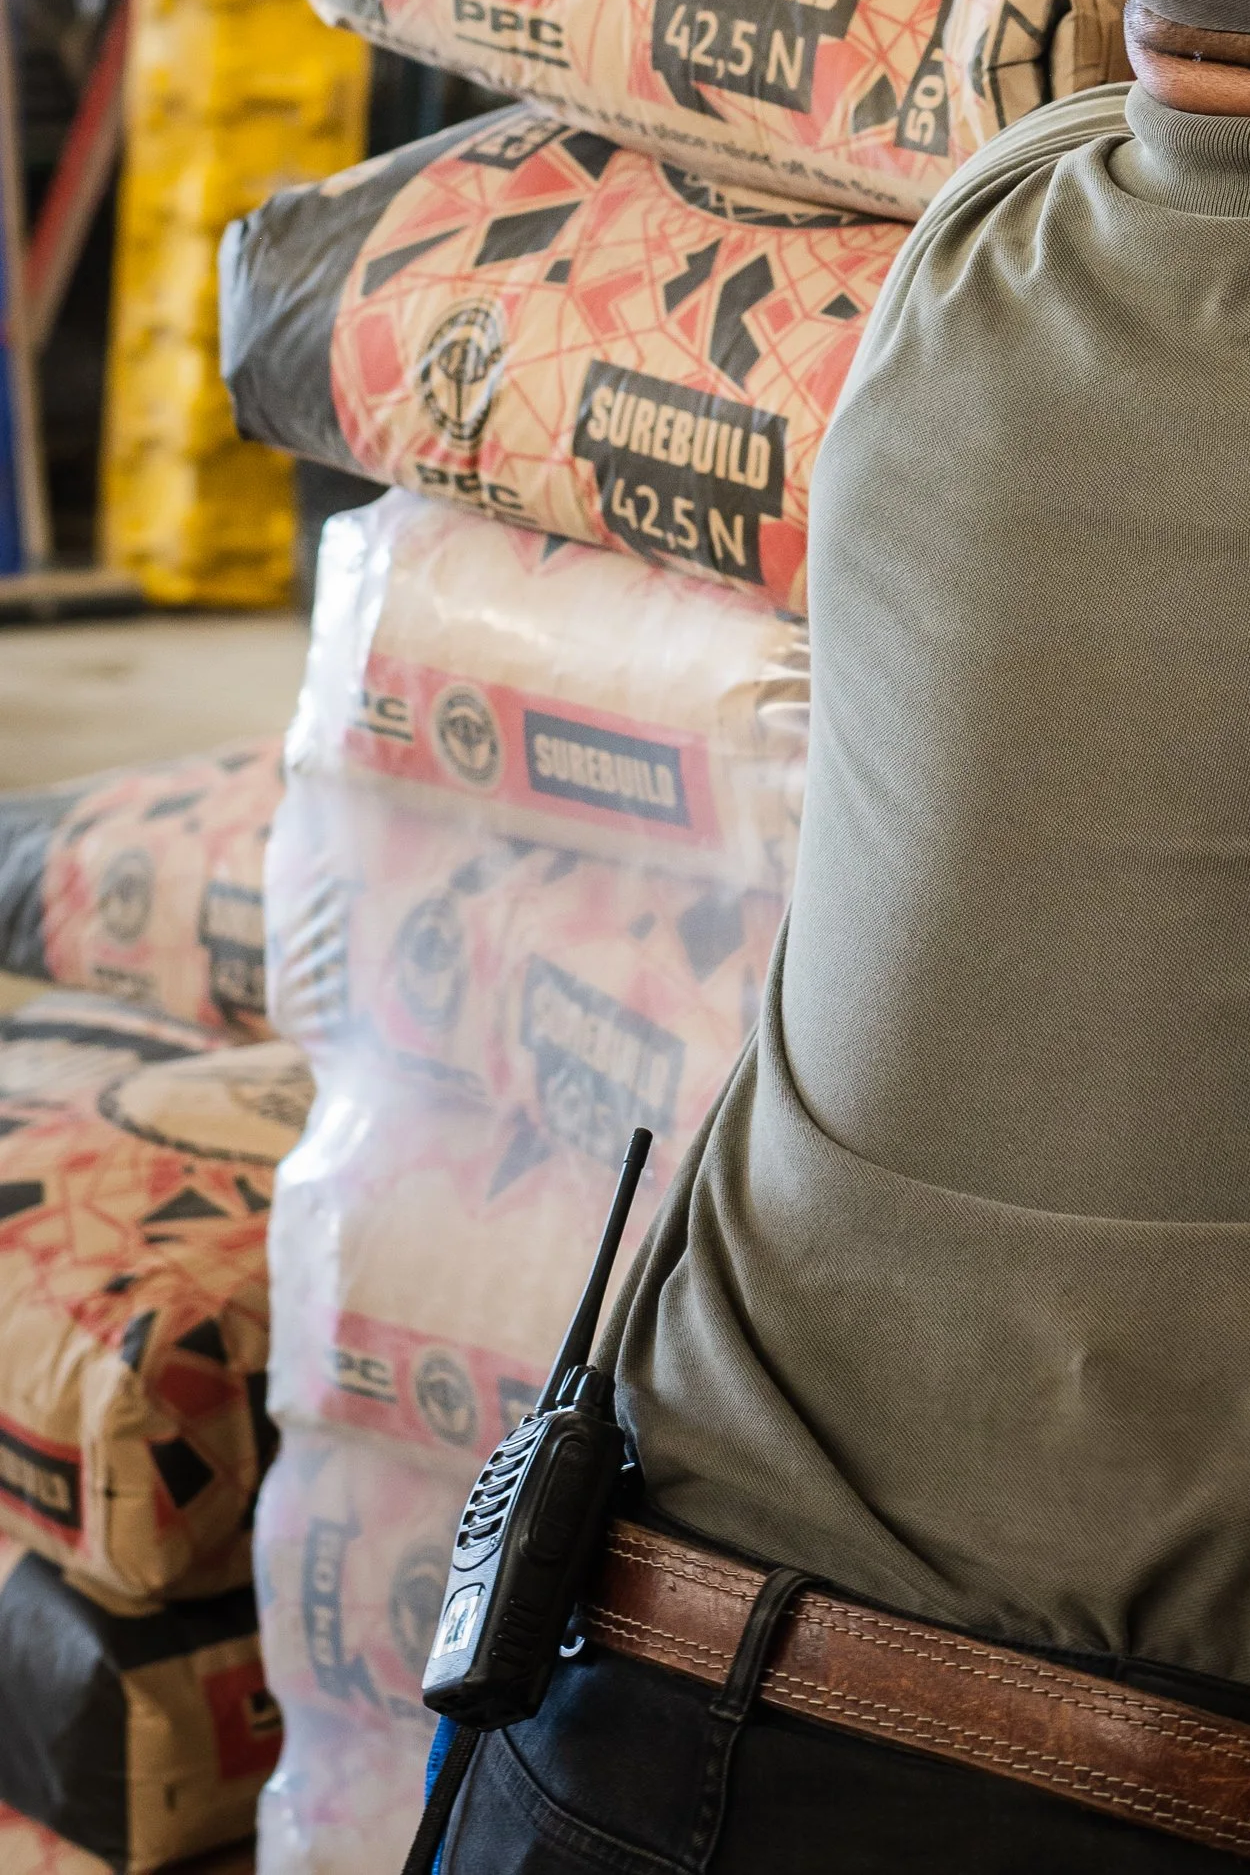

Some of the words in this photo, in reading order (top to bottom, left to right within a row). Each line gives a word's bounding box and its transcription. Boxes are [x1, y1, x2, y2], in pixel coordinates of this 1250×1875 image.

[665, 4, 757, 80] 42,5
[766, 29, 806, 91] N
[904, 74, 945, 147] 50
[587, 384, 770, 490] SUREBUILD
[611, 478, 699, 549] 42,5
[709, 508, 747, 566] N
